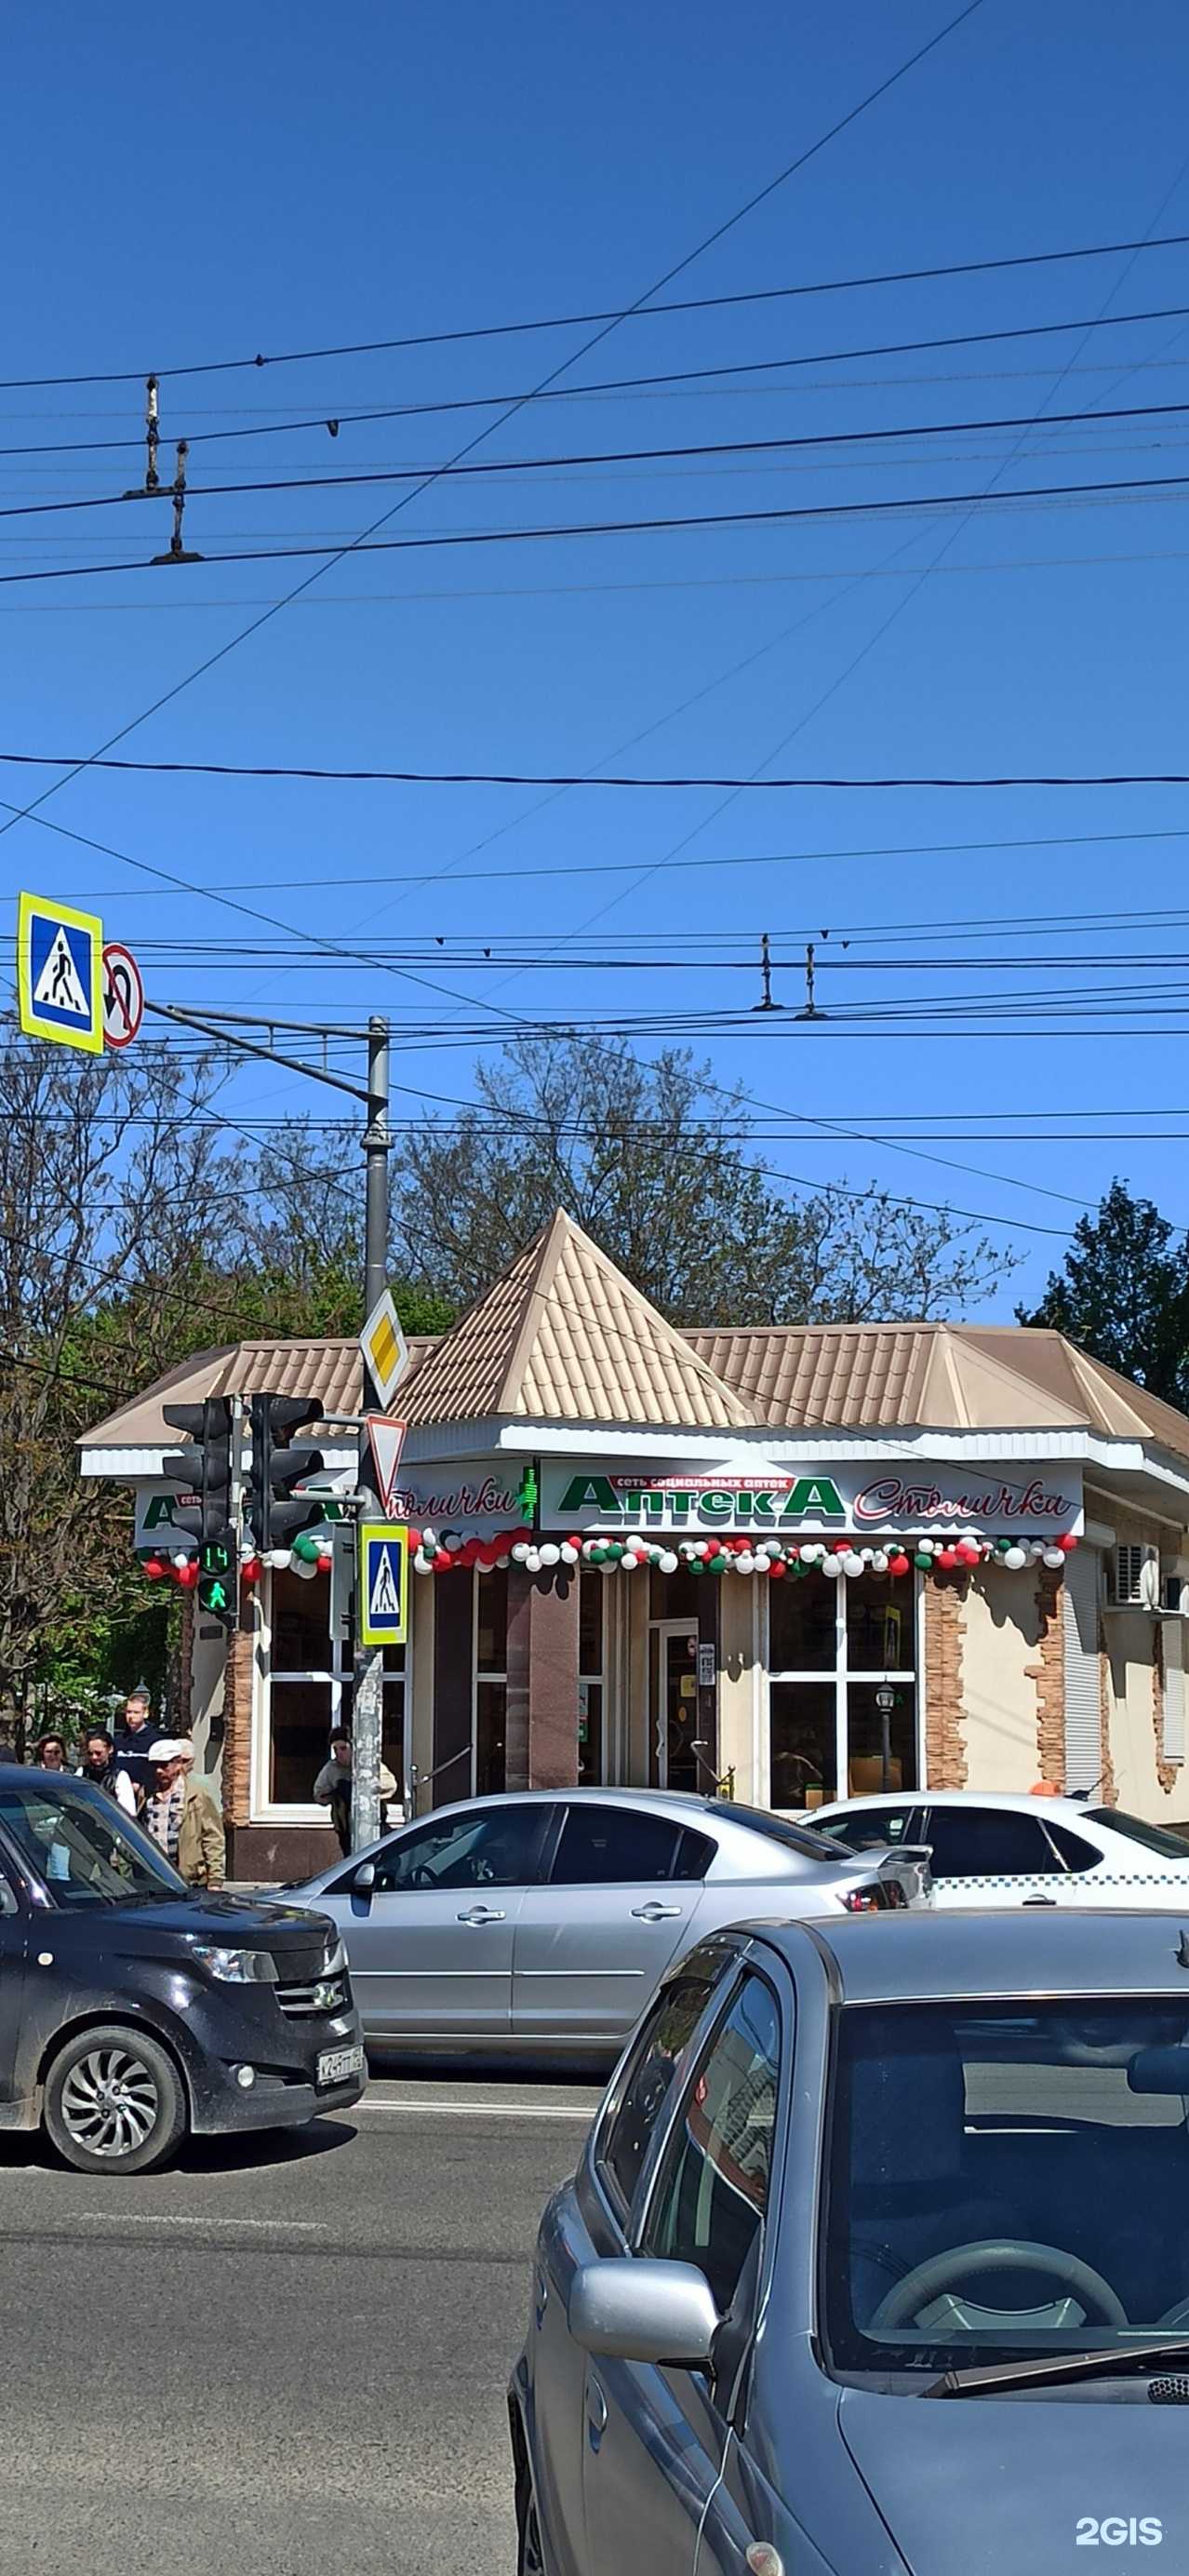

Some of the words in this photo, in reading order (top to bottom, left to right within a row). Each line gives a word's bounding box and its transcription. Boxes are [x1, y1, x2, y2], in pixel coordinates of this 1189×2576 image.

[387, 1476, 515, 1521] толички
[618, 1478, 648, 1487] сеть
[650, 1478, 742, 1488] социальных
[744, 1478, 788, 1488] аптек
[853, 1476, 1071, 1521] Столички
[207, 1547, 227, 1567] 14
